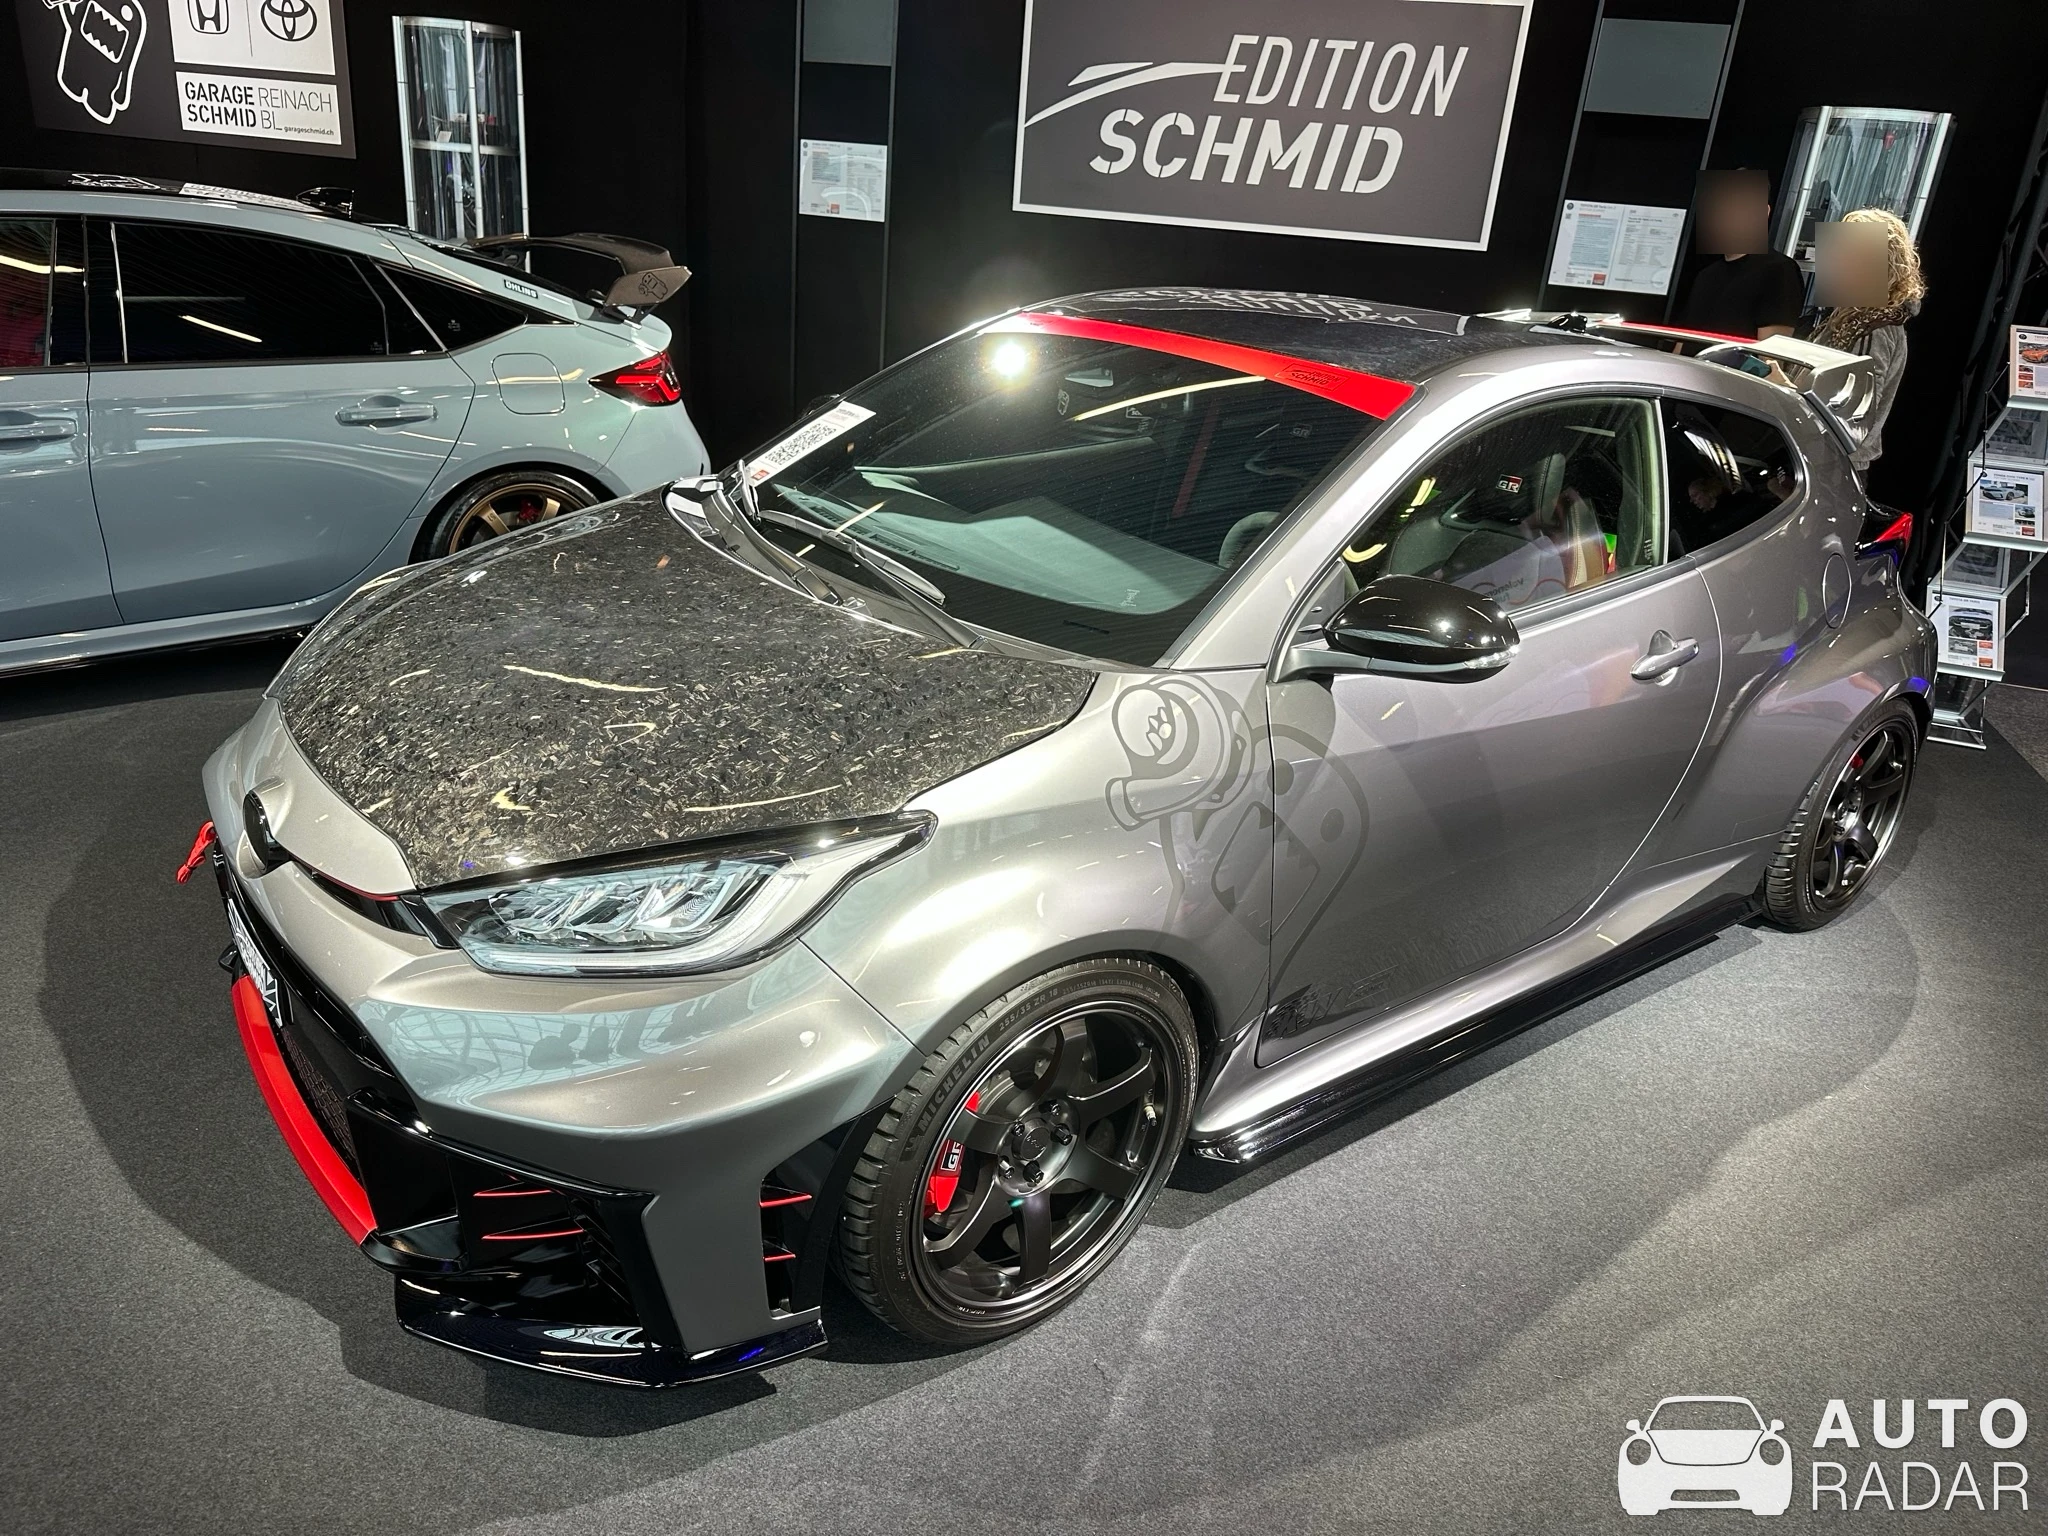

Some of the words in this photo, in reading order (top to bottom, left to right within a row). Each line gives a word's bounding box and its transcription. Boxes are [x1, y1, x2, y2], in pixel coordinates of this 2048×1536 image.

[1213, 34, 1469, 117] EDITION
[184, 81, 255, 106] GARAGE
[258, 87, 332, 113] REINACH
[187, 103, 256, 128] SCHMID
[284, 125, 334, 136] garageschmid.ch
[1089, 108, 1404, 194] SCHMID
[1290, 372, 1330, 386] SCHMID
[1499, 479, 1520, 492] GR
[917, 1034, 992, 1136] MICHELIN
[999, 1003, 1032, 1031] 255/35
[1033, 993, 1047, 1006] ZR
